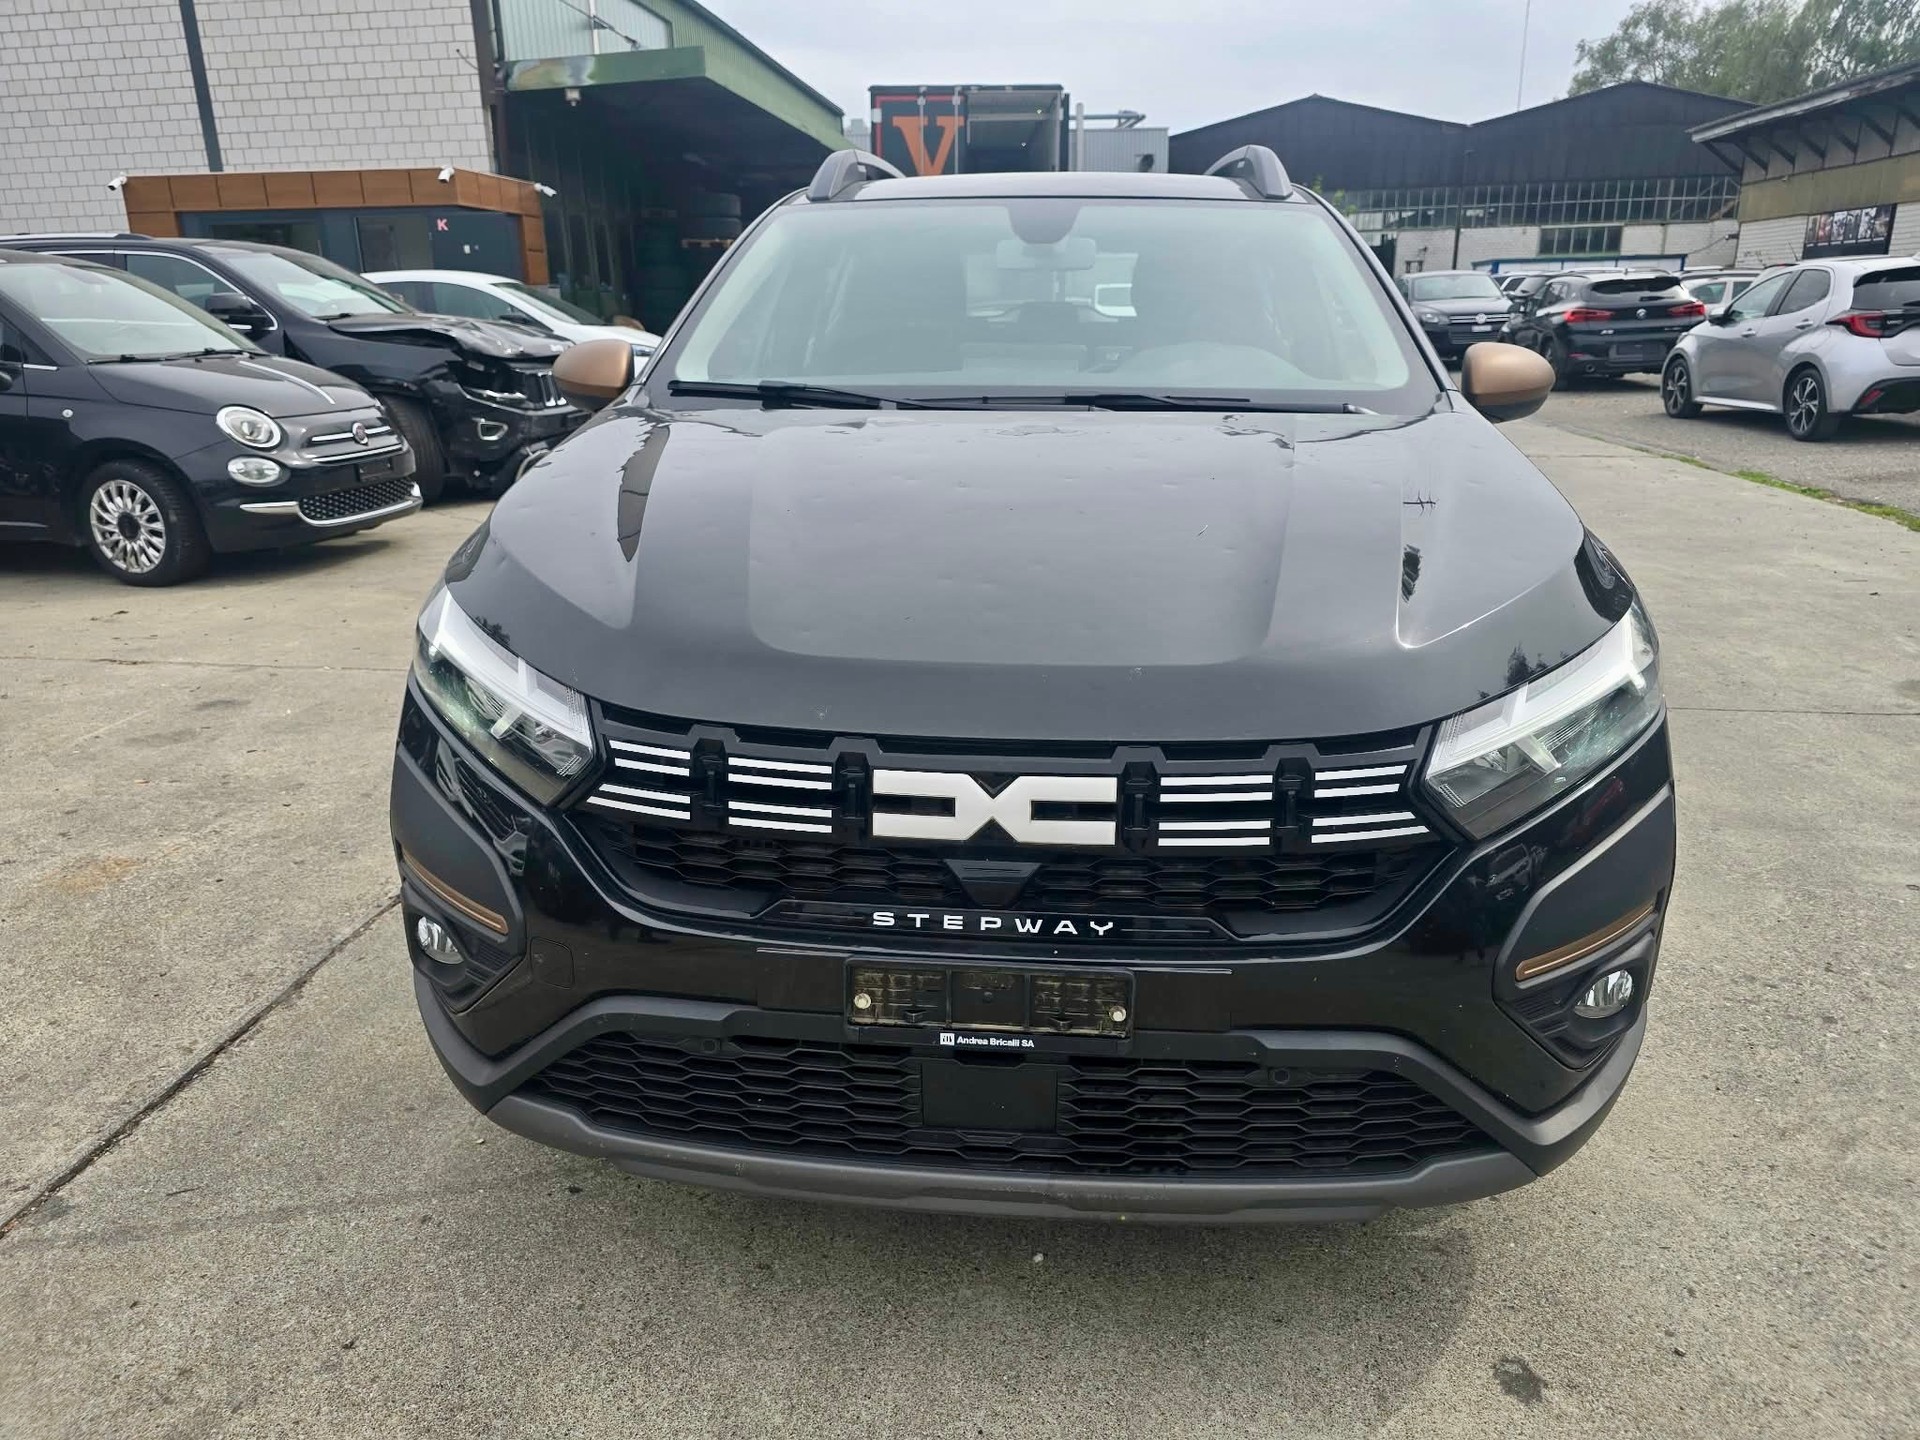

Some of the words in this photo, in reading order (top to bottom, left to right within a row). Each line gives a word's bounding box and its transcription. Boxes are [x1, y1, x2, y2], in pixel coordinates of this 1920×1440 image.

[892, 116, 965, 176] V
[437, 218, 449, 231] K
[872, 911, 1114, 936] STEPWAY
[956, 1036, 989, 1046] Andrea
[1021, 1039, 1035, 1048] SA
